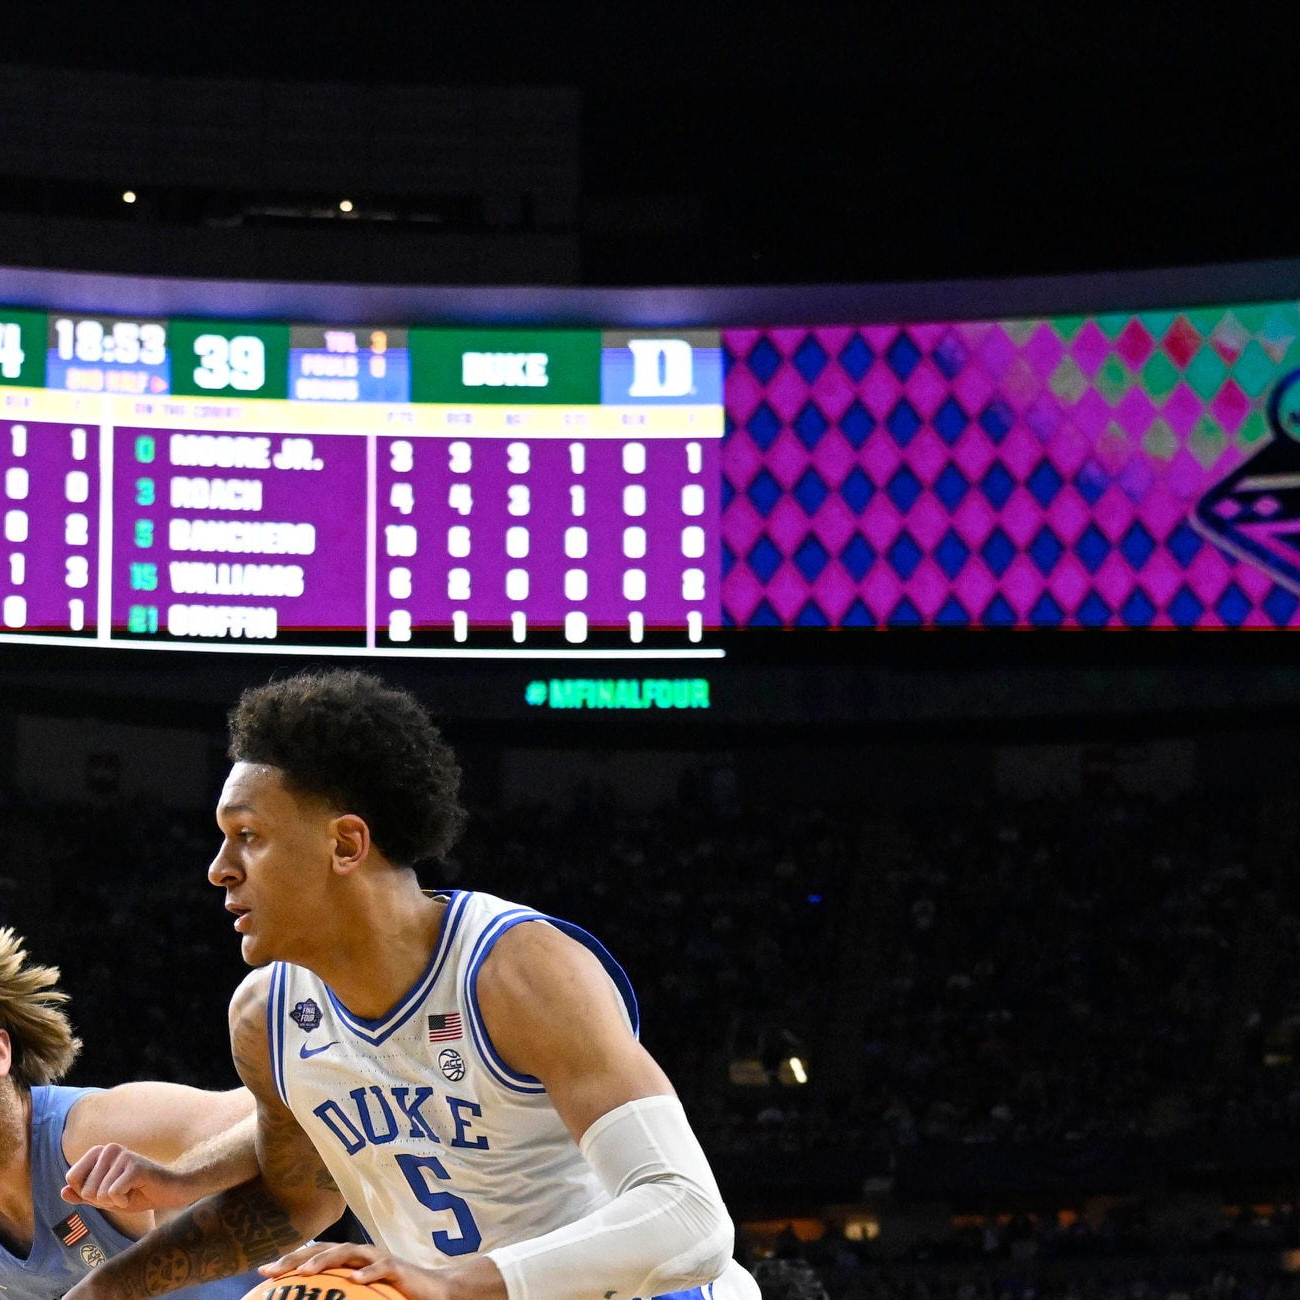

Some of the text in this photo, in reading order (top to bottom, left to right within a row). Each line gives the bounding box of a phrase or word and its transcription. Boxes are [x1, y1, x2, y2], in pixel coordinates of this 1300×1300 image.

[55, 319, 166, 365] 18:53
[194, 335, 265, 390] 39
[462, 352, 549, 387] DUKE
[313, 1085, 490, 1156] DUKE
[394, 1153, 483, 1258] 5
